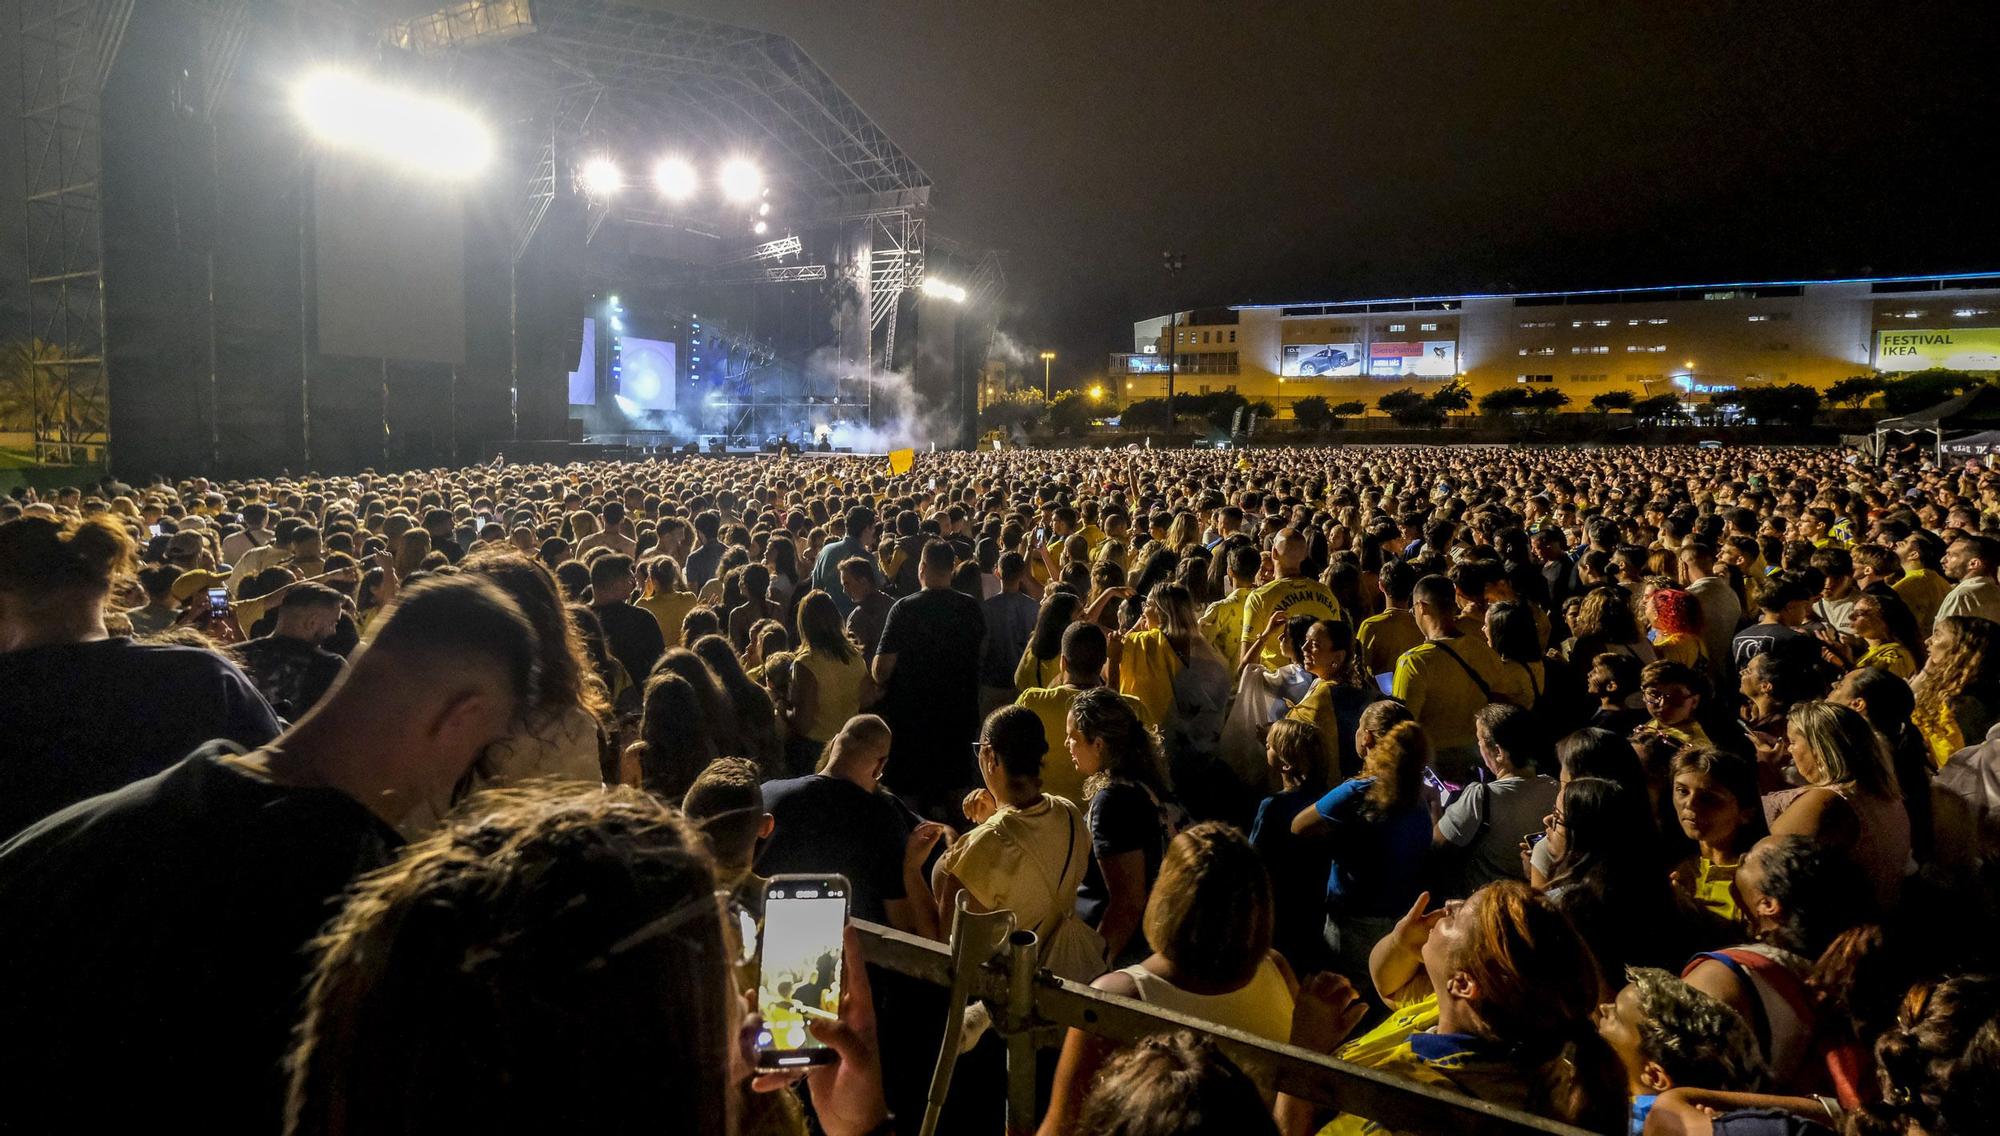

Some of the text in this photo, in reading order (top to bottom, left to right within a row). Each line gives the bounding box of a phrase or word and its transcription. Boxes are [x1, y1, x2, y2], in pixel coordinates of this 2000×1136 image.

[1884, 334, 1954, 346] FESTIVAL
[1883, 346, 1917, 356] IKEA
[1274, 590, 1314, 611] NATHAN
